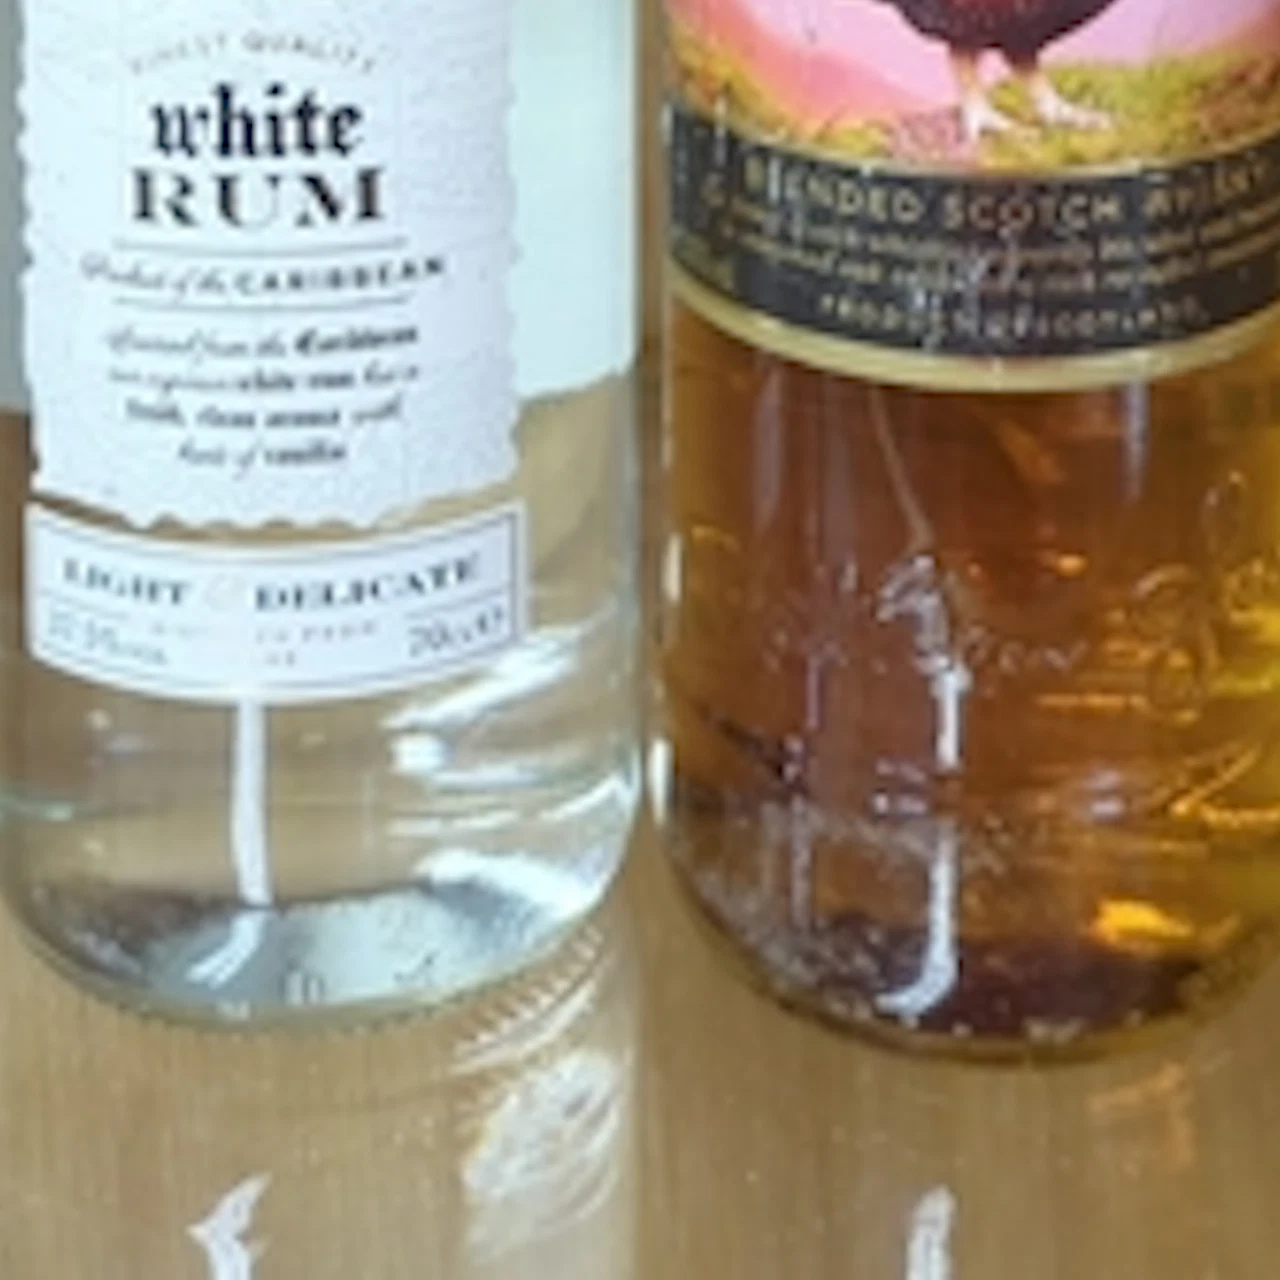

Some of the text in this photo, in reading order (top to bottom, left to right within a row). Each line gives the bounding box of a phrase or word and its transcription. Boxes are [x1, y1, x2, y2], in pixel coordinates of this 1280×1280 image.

[150, 81, 366, 160] white
[132, 166, 385, 229] RUM
[941, 190, 1122, 232] SCOTCH
[63, 556, 194, 607] LIGHT
[254, 550, 481, 612] DELICATE
